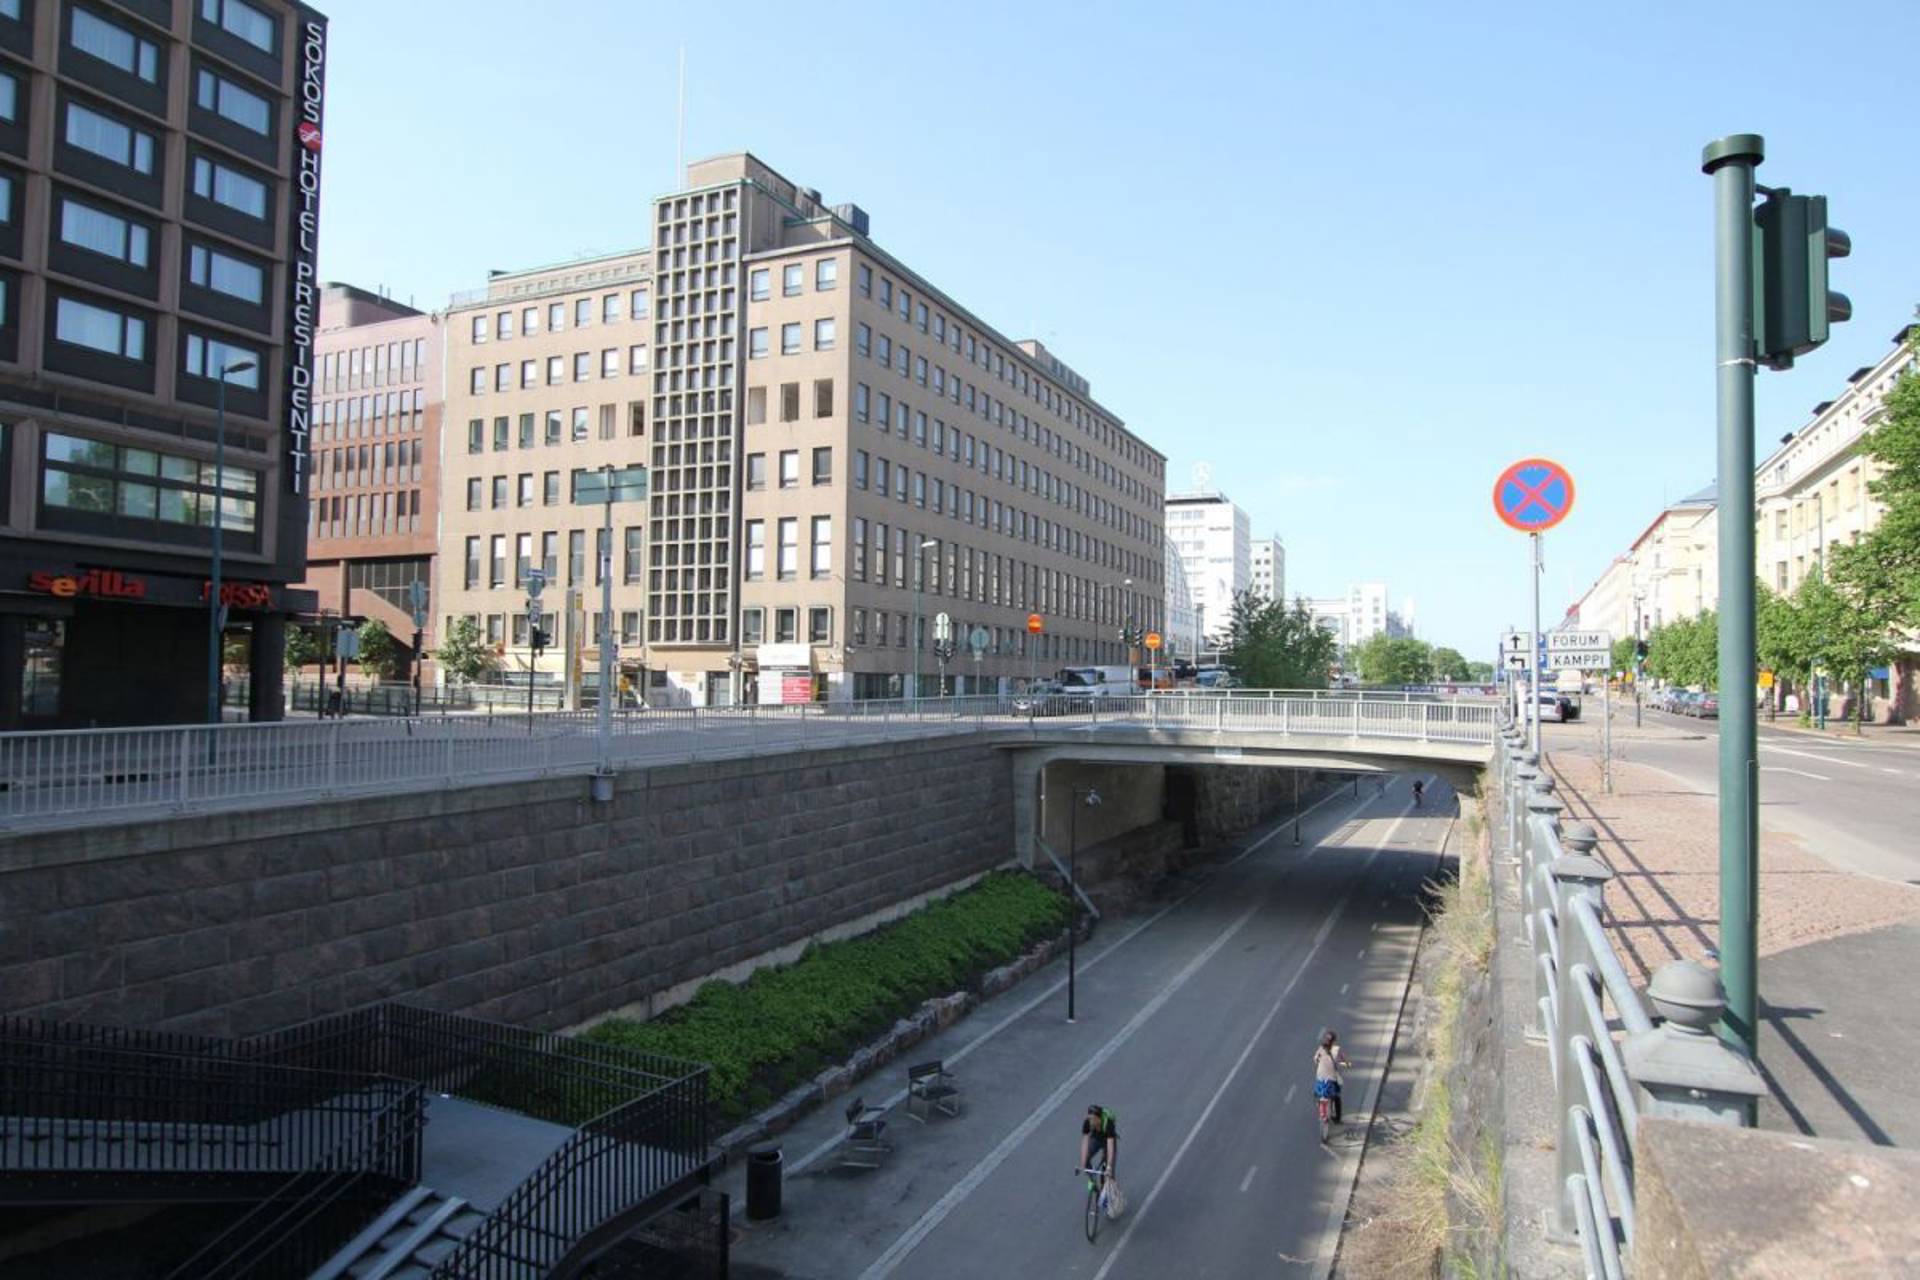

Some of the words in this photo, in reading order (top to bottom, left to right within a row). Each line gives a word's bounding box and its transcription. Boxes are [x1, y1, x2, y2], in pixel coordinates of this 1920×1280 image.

[304, 22, 322, 123] SOKOS
[300, 148, 318, 253] HOTEL
[290, 261, 313, 494] PRESIDENTTI
[1553, 635, 1599, 646] FORUM
[1554, 653, 1604, 666] KAMPPI
